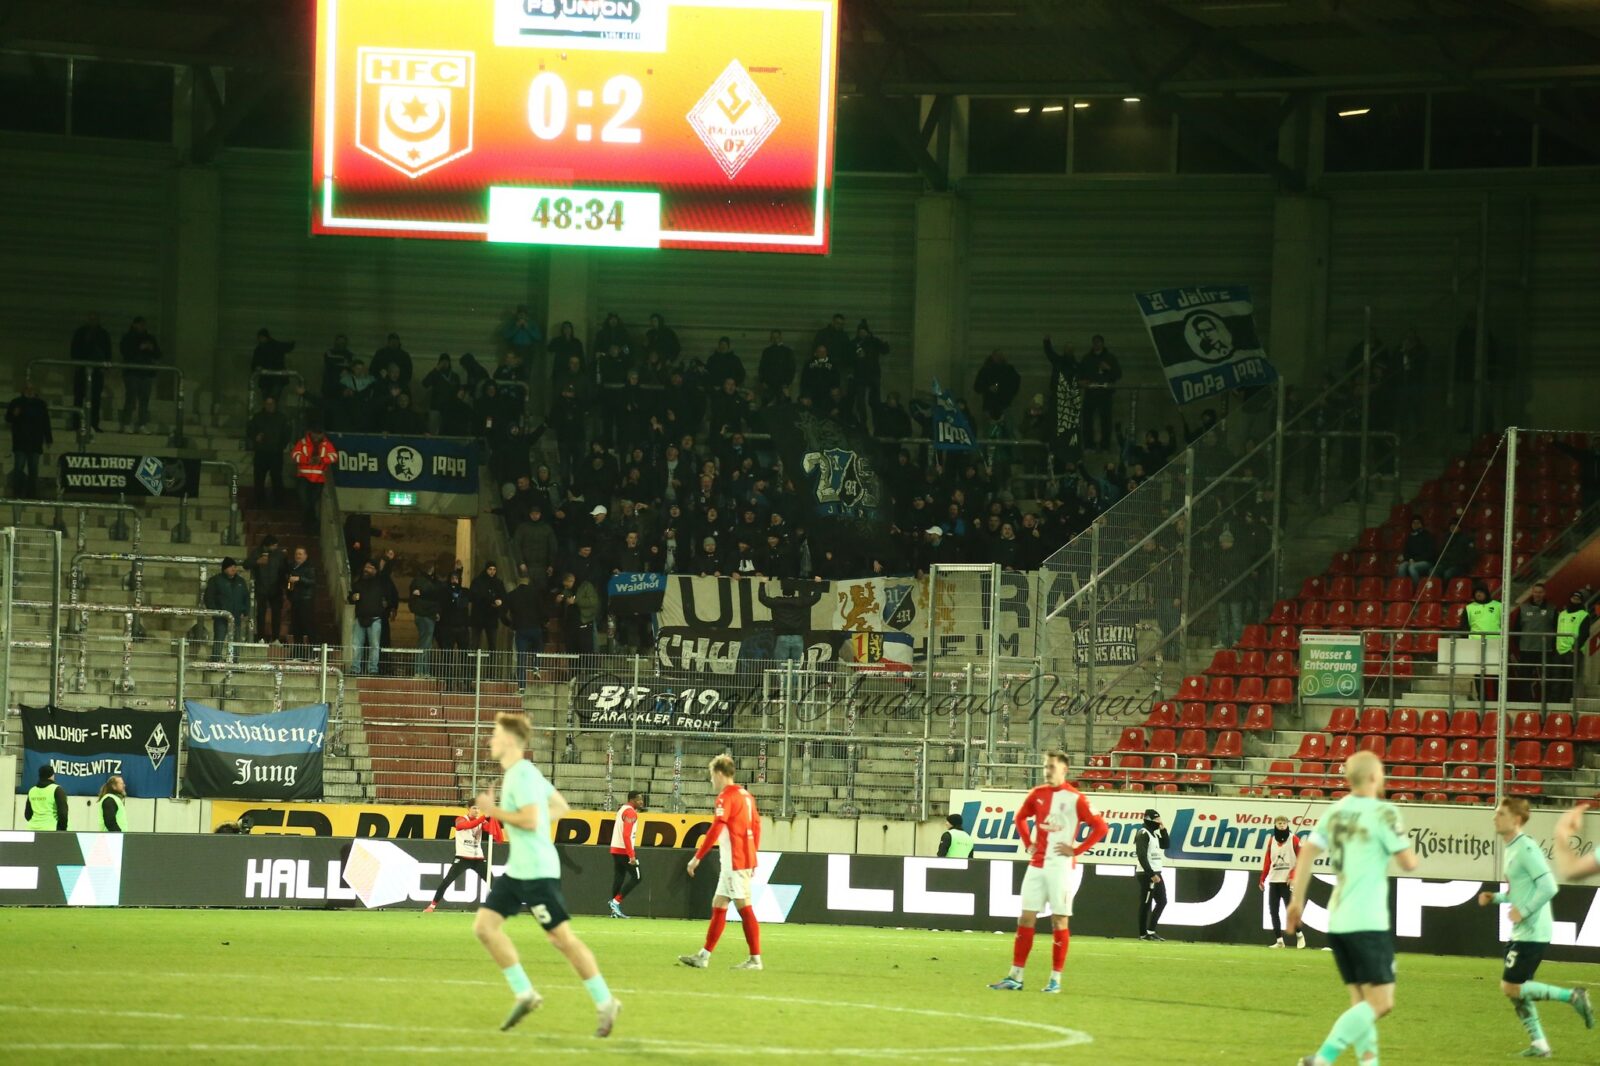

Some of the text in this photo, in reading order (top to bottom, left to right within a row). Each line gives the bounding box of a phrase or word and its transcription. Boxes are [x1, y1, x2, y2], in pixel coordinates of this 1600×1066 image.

[562, 0, 632, 17] UNION
[371, 58, 459, 83] HFC
[528, 72, 643, 143] 0:2
[531, 197, 624, 231] 48:34
[1182, 374, 1225, 402] DoPa
[65, 456, 136, 470] WALDHOF
[338, 450, 379, 472] DoPa
[66, 474, 126, 487] WOLVES
[615, 579, 659, 592] Waldhof
[630, 573, 646, 583] SV
[1077, 625, 1134, 644] KOLEKTIV
[1110, 646, 1136, 661] ACHT
[1310, 649, 1352, 659] Wasser &
[1304, 660, 1357, 672] Entsorgung
[190, 719, 325, 748] Cuxhavener
[677, 717, 721, 732] FRONT
[50, 758, 122, 777] MEUSELWITZ
[232, 758, 298, 787] Jung
[1240, 854, 1261, 863] an
[245, 858, 357, 900] HALL
